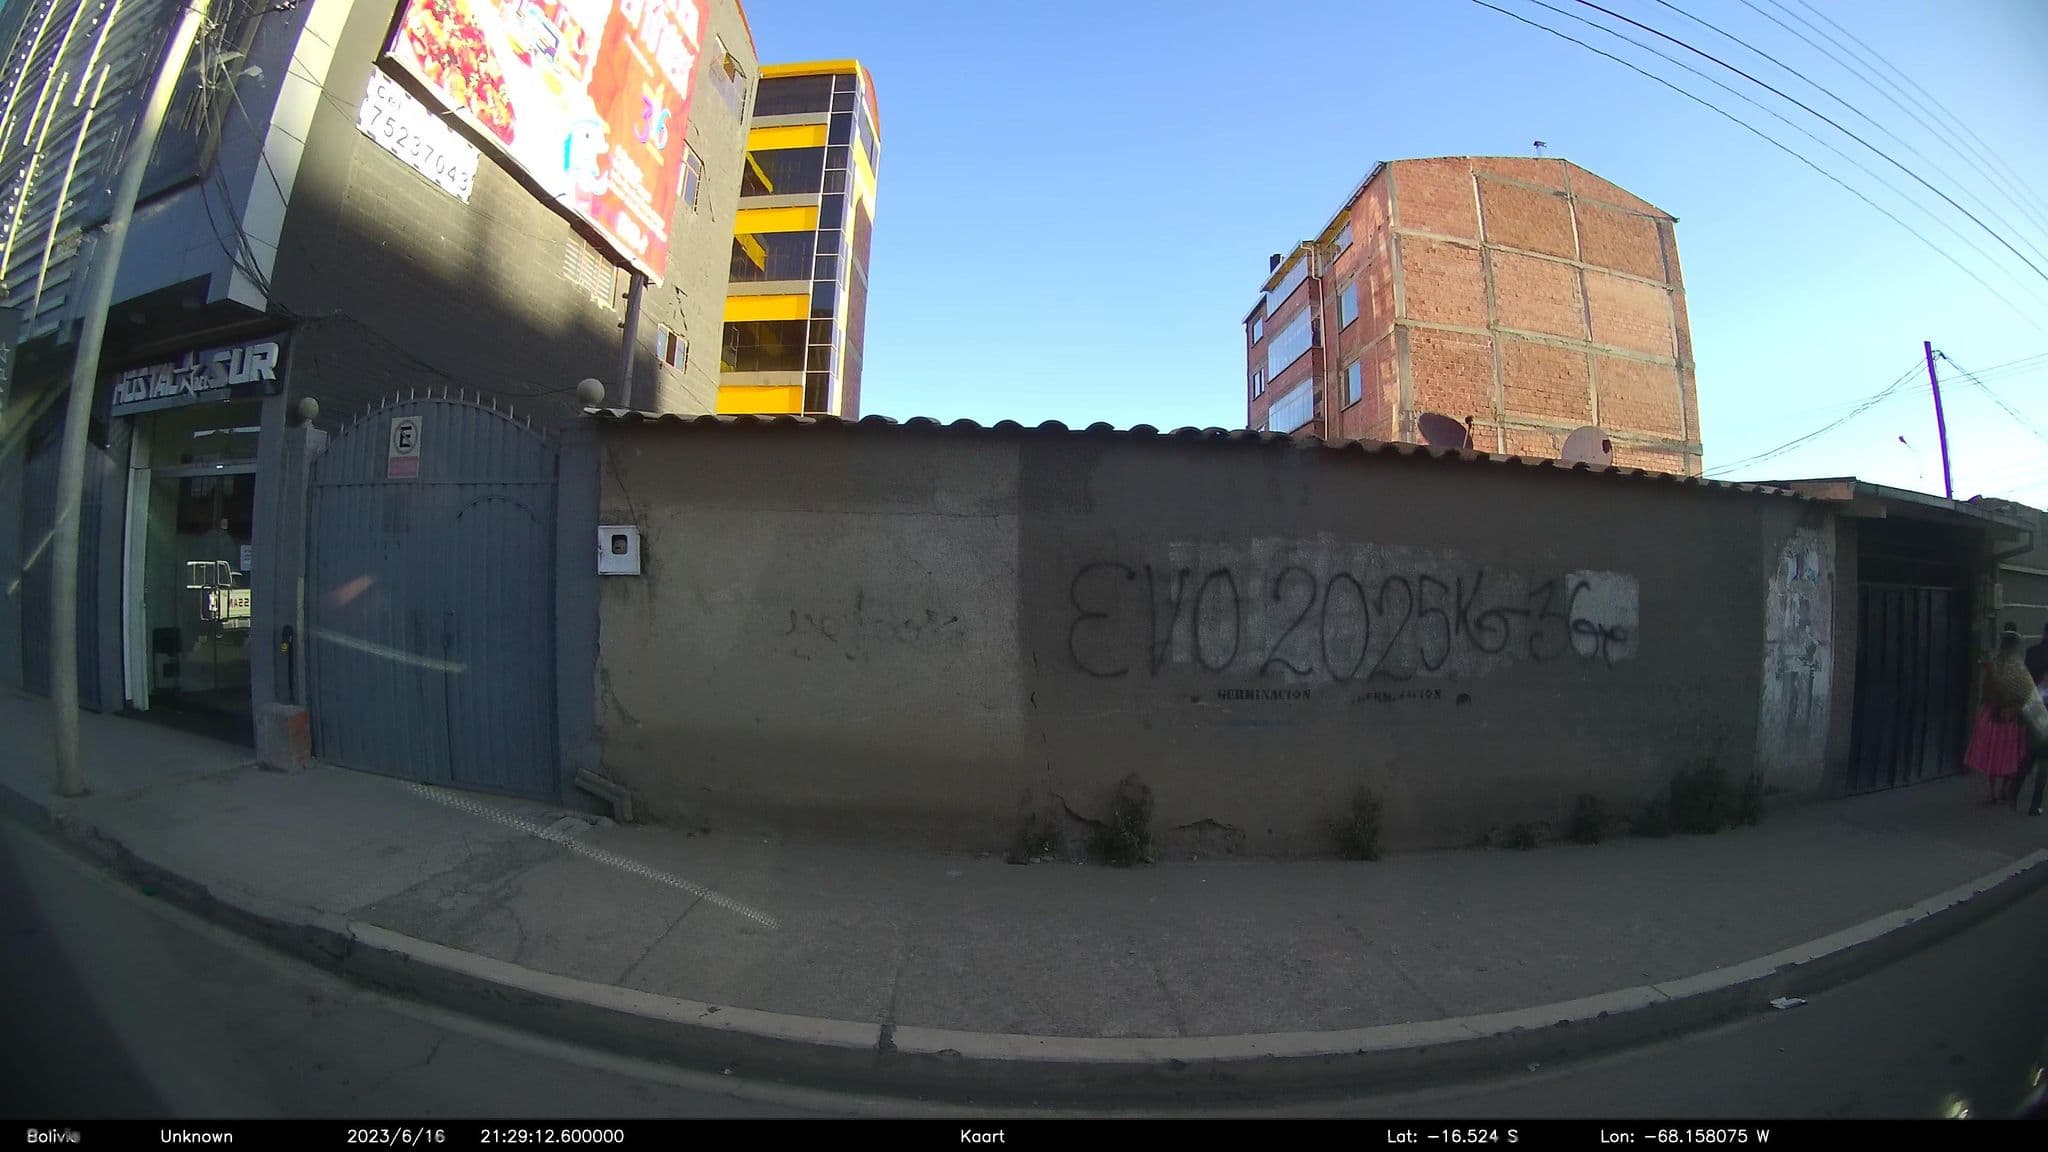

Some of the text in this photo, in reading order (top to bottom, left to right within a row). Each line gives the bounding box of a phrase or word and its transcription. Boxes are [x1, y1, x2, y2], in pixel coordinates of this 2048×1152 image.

[370, 105, 469, 192] 75237043
[113, 361, 179, 406] HOSTAL
[206, 341, 280, 390] SUR
[399, 425, 413, 448] E
[1067, 560, 1242, 678] EVO
